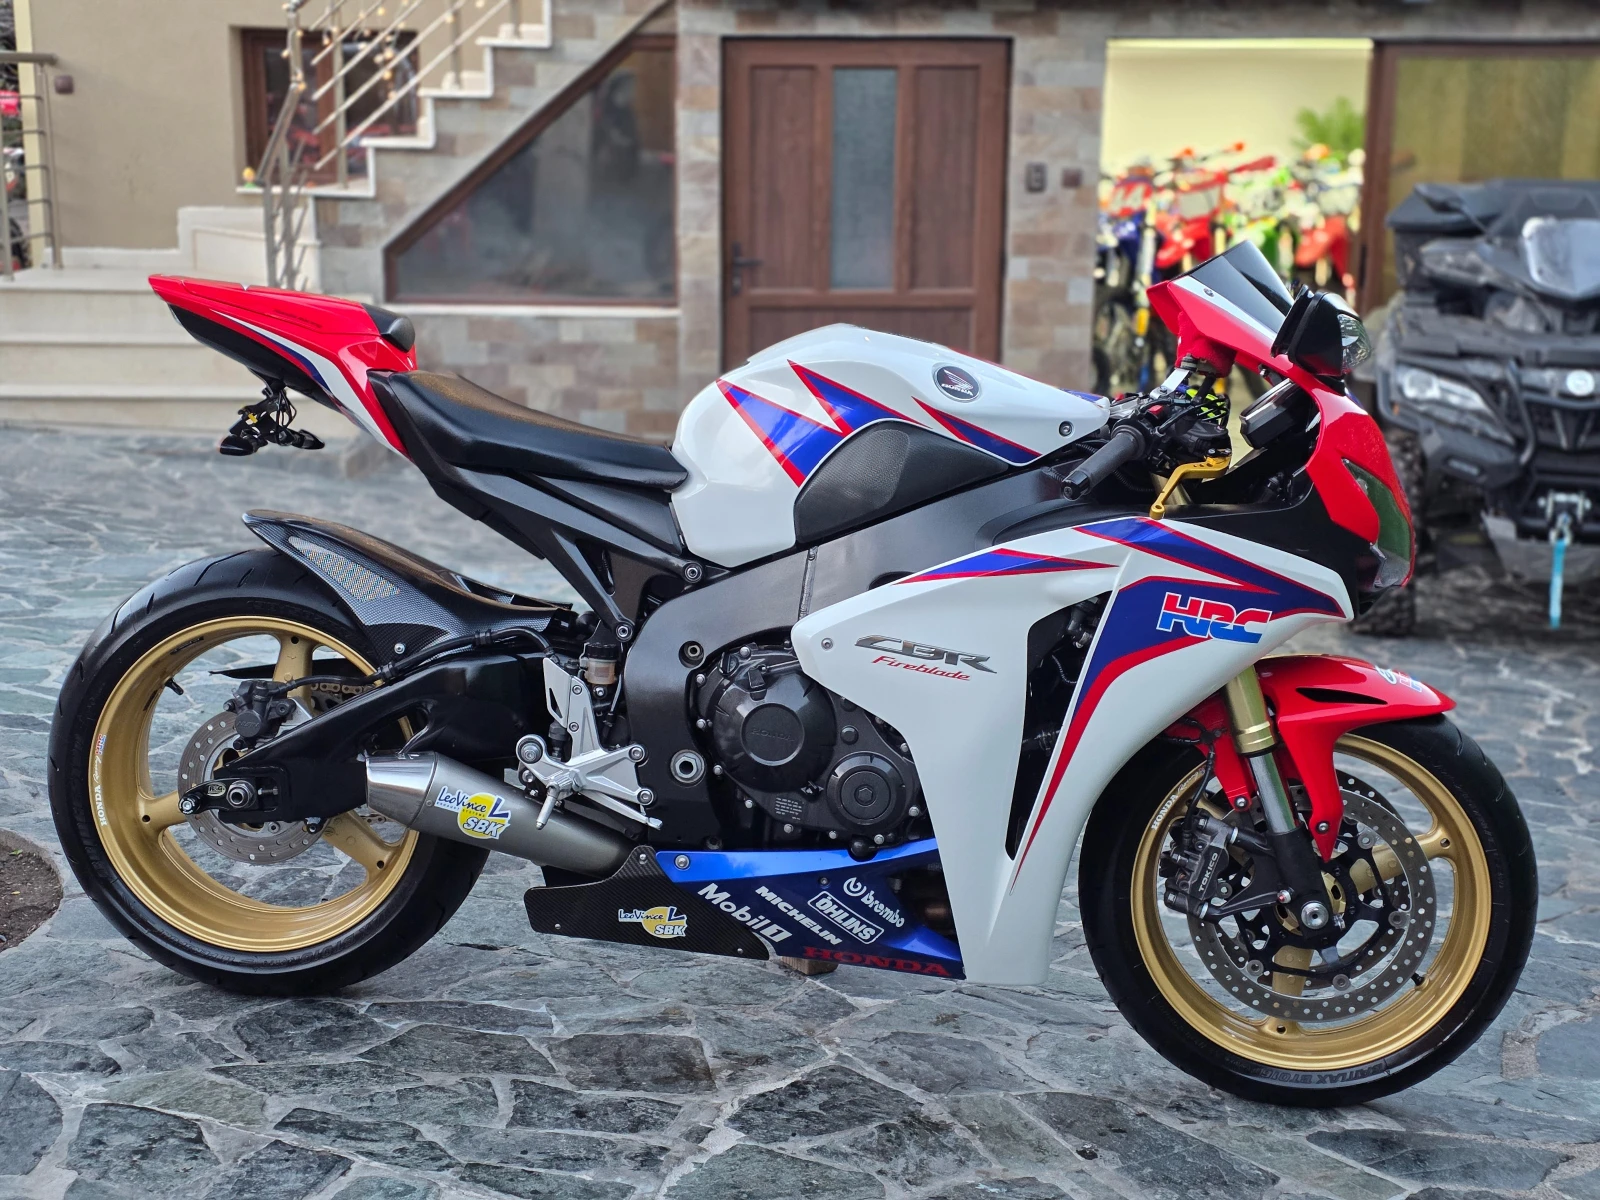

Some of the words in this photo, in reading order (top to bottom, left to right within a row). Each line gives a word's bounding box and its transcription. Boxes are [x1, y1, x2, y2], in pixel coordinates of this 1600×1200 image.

[941, 383, 974, 396] HONDA
[1156, 592, 1272, 644] HRC
[855, 635, 997, 674] CBR
[871, 655, 970, 681] Fireblade
[94, 785, 107, 826] HONDA
[438, 786, 487, 812] LeoVince
[1151, 794, 1178, 830] HONDA
[463, 816, 505, 838] SBK
[1198, 852, 1218, 892] TOKICO
[619, 909, 664, 920] LeoVince
[697, 882, 771, 931] Mobil
[755, 885, 843, 946] MICHELIN
[815, 896, 876, 941] ÖHLINS
[860, 890, 905, 928] brembo
[654, 924, 685, 936] SBK
[802, 946, 952, 977] HONDA
